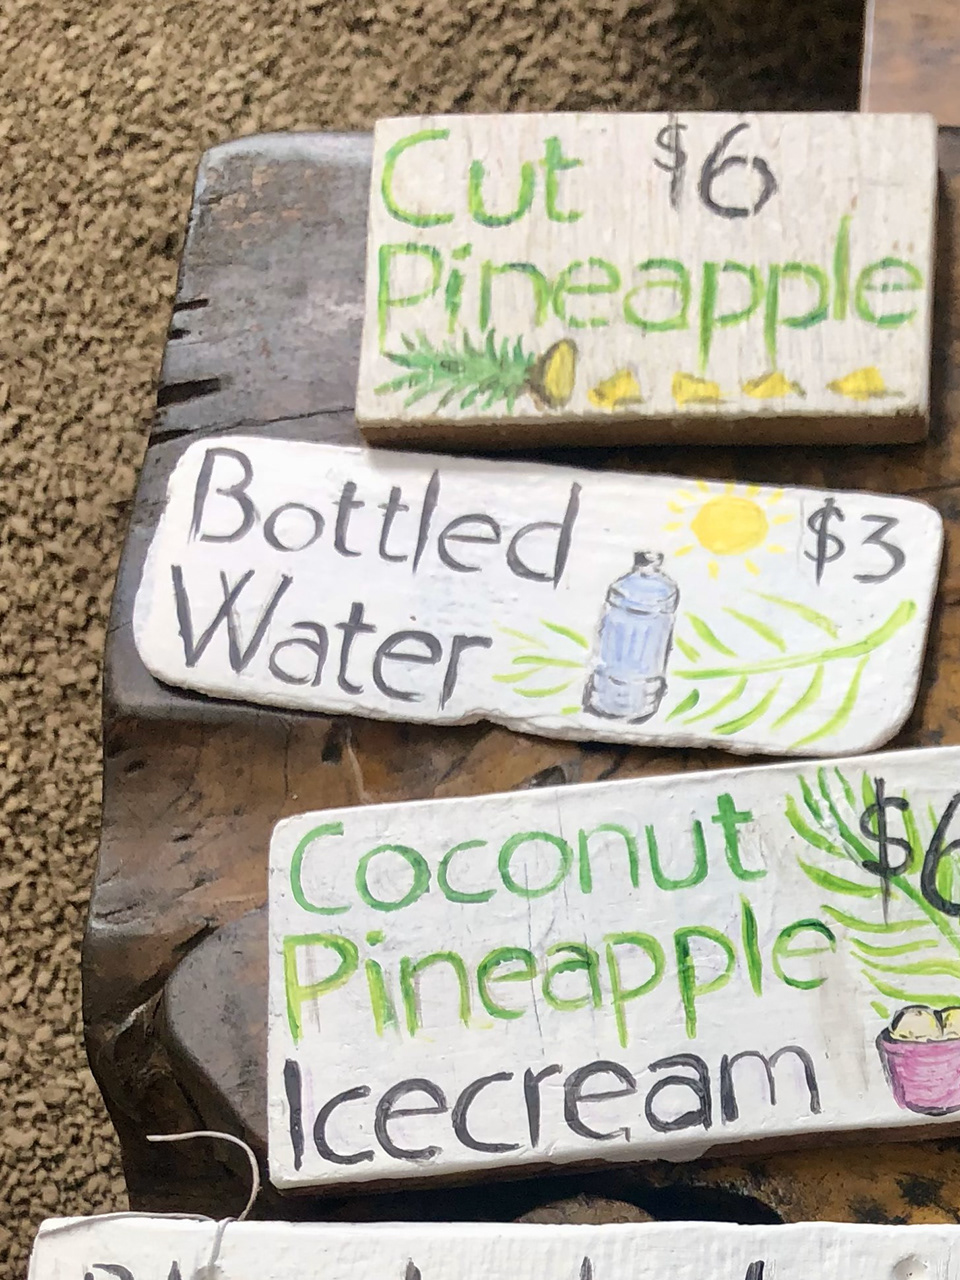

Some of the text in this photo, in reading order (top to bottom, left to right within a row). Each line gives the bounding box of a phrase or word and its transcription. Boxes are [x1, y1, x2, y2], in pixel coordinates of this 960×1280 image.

[380, 113, 777, 228] Cut $6
[378, 213, 923, 373] Pineapple
[191, 448, 905, 588] Bottled $3
[172, 564, 492, 709] Water
[290, 793, 766, 914] Coconut
[282, 894, 836, 1047] Pineapple
[284, 1046, 821, 1170] Icecream
